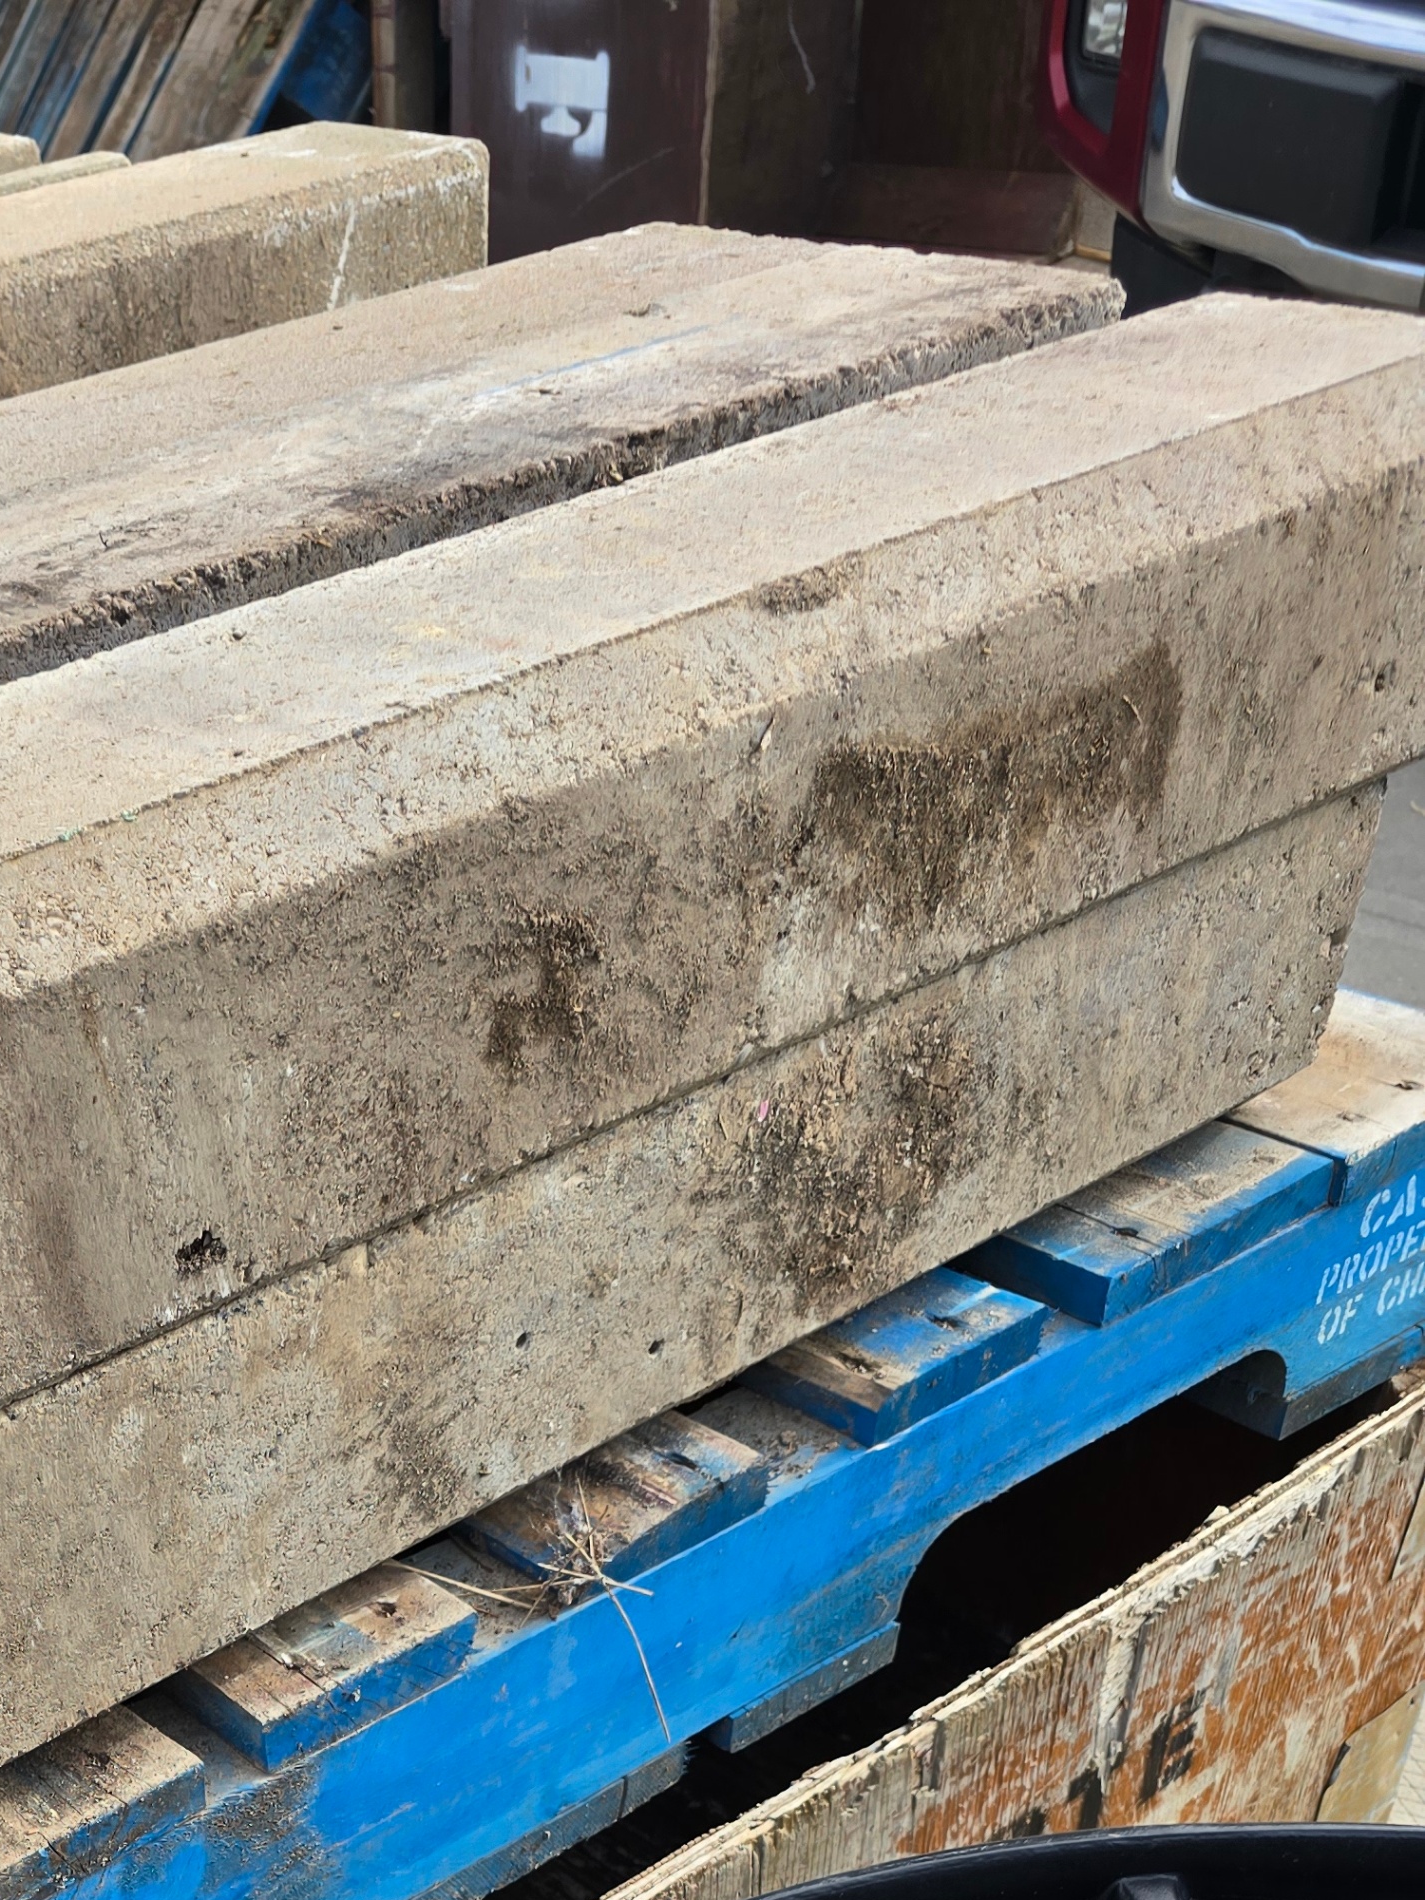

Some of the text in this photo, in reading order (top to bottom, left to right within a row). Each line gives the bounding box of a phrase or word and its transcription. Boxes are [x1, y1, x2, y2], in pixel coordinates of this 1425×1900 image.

[1360, 1174, 1425, 1238] CA
[1316, 1220, 1425, 1305] PROPE
[1317, 1293, 1363, 1344] OF
